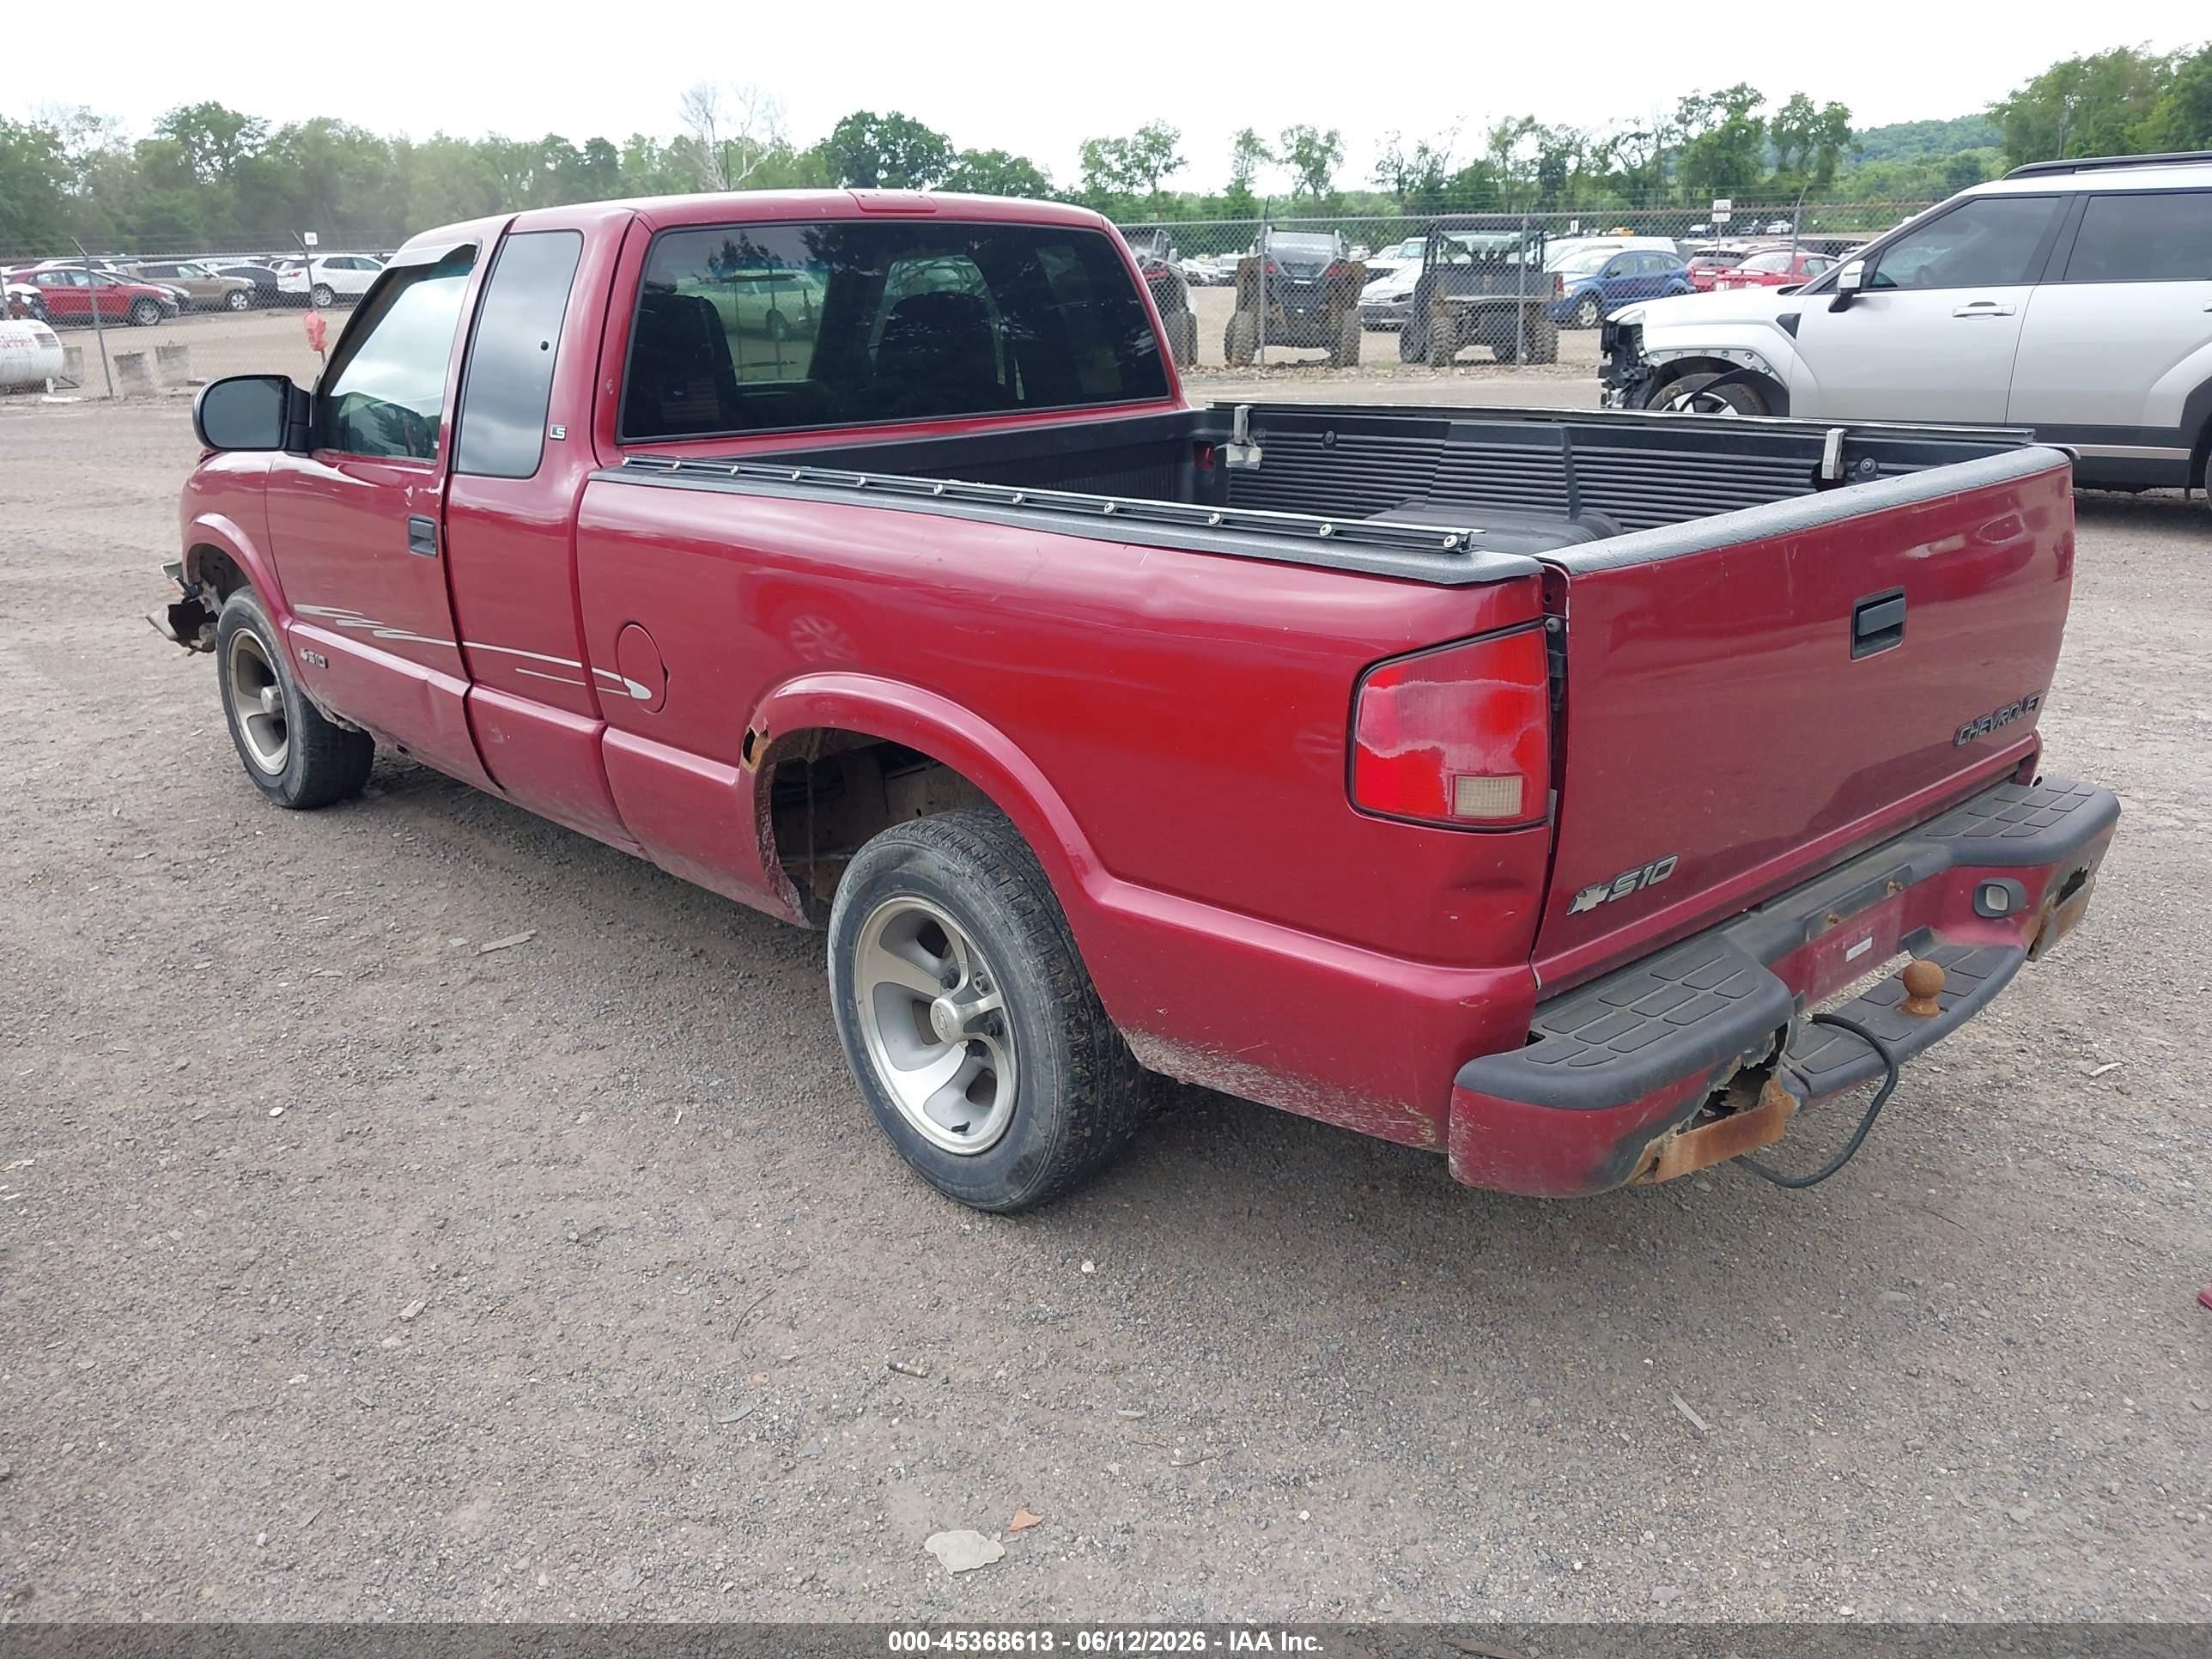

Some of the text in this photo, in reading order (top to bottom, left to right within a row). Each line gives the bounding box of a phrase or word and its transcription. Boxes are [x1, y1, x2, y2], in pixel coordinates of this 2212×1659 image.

[550, 425, 567, 441] LS
[1954, 689, 2044, 747] CHEVROLET
[1607, 853, 1680, 903] S10
